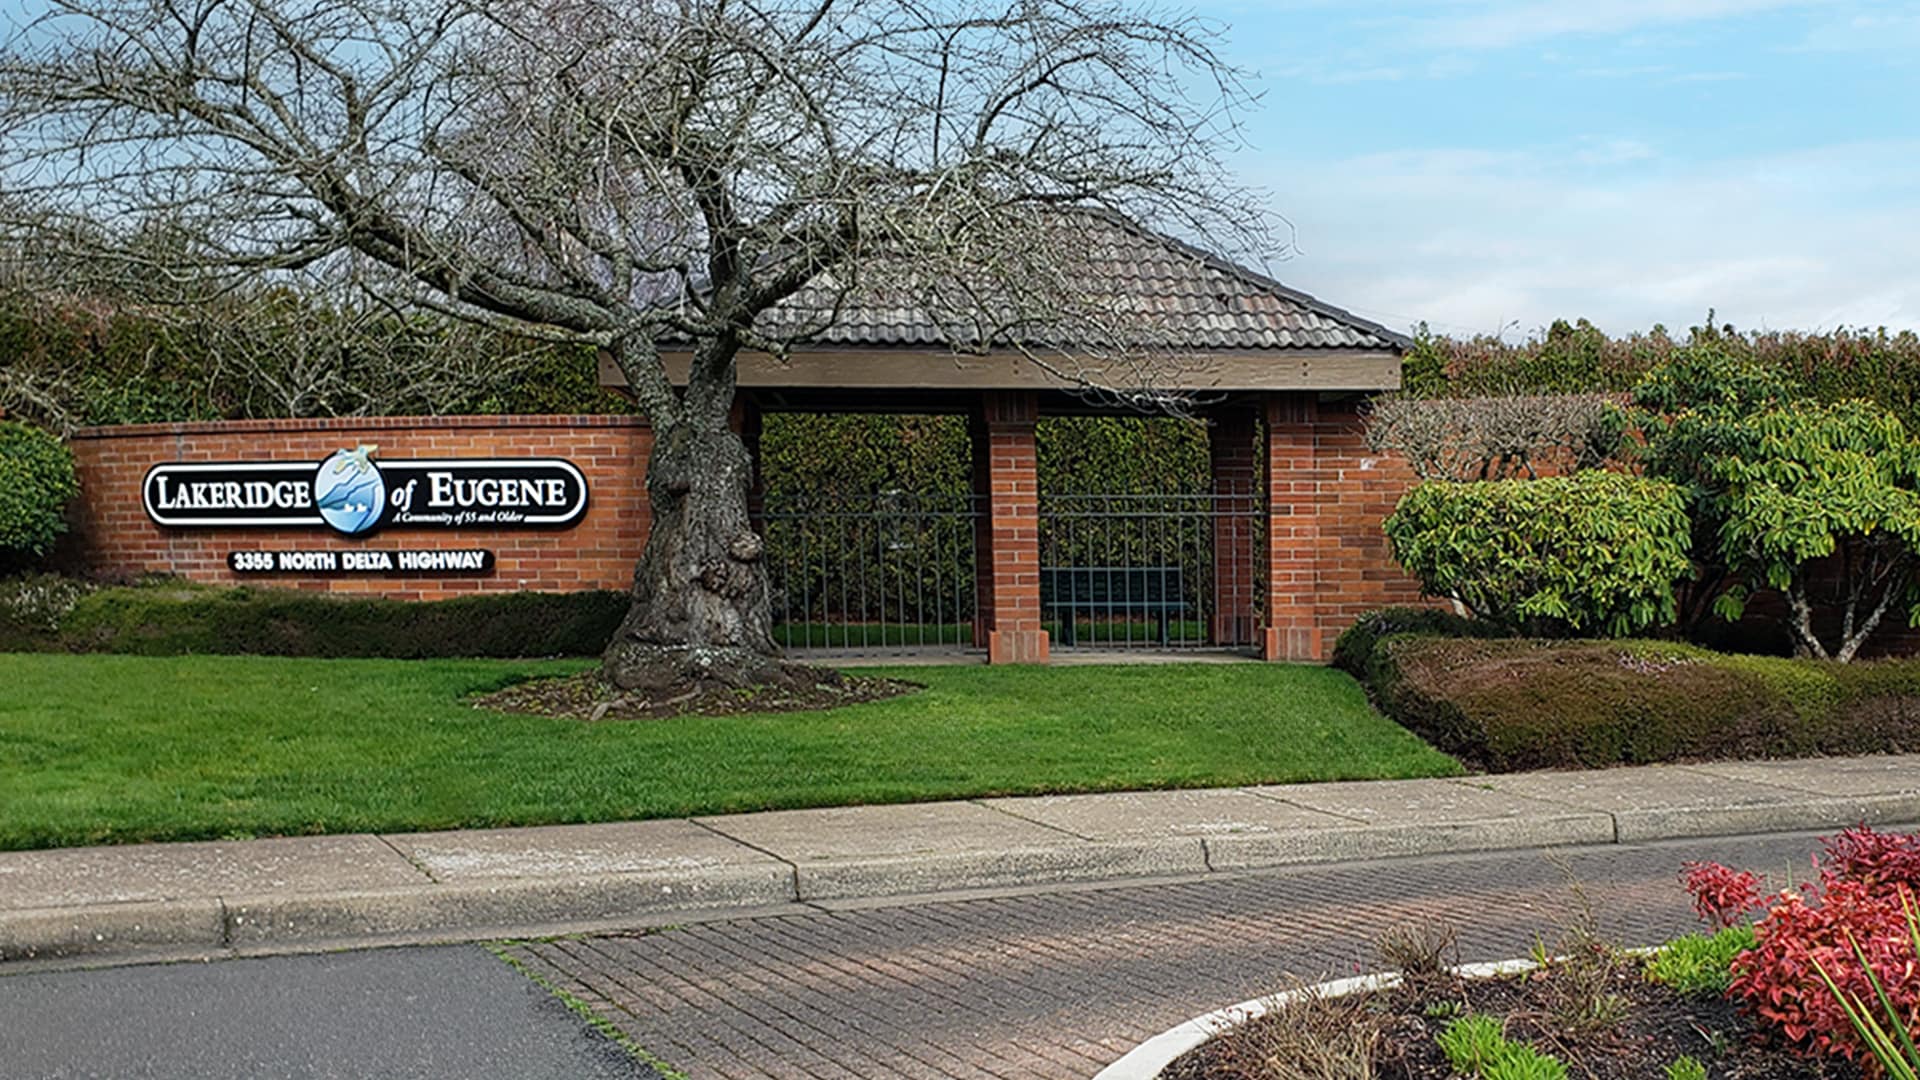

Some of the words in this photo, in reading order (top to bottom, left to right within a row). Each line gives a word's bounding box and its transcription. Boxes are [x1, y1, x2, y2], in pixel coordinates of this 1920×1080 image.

[156, 476, 311, 509] LAKERIDGE
[391, 479, 417, 512] of
[427, 472, 567, 507] EUGENE
[392, 512, 401, 522] A
[402, 512, 452, 525] Community
[454, 511, 466, 525] of
[465, 511, 477, 523] 55
[478, 511, 496, 523] and
[497, 511, 523, 523] Older
[234, 553, 274, 570] 3355
[279, 553, 336, 570] NORTH
[342, 552, 392, 570] DELTA
[399, 551, 485, 570] HIGHWAY
